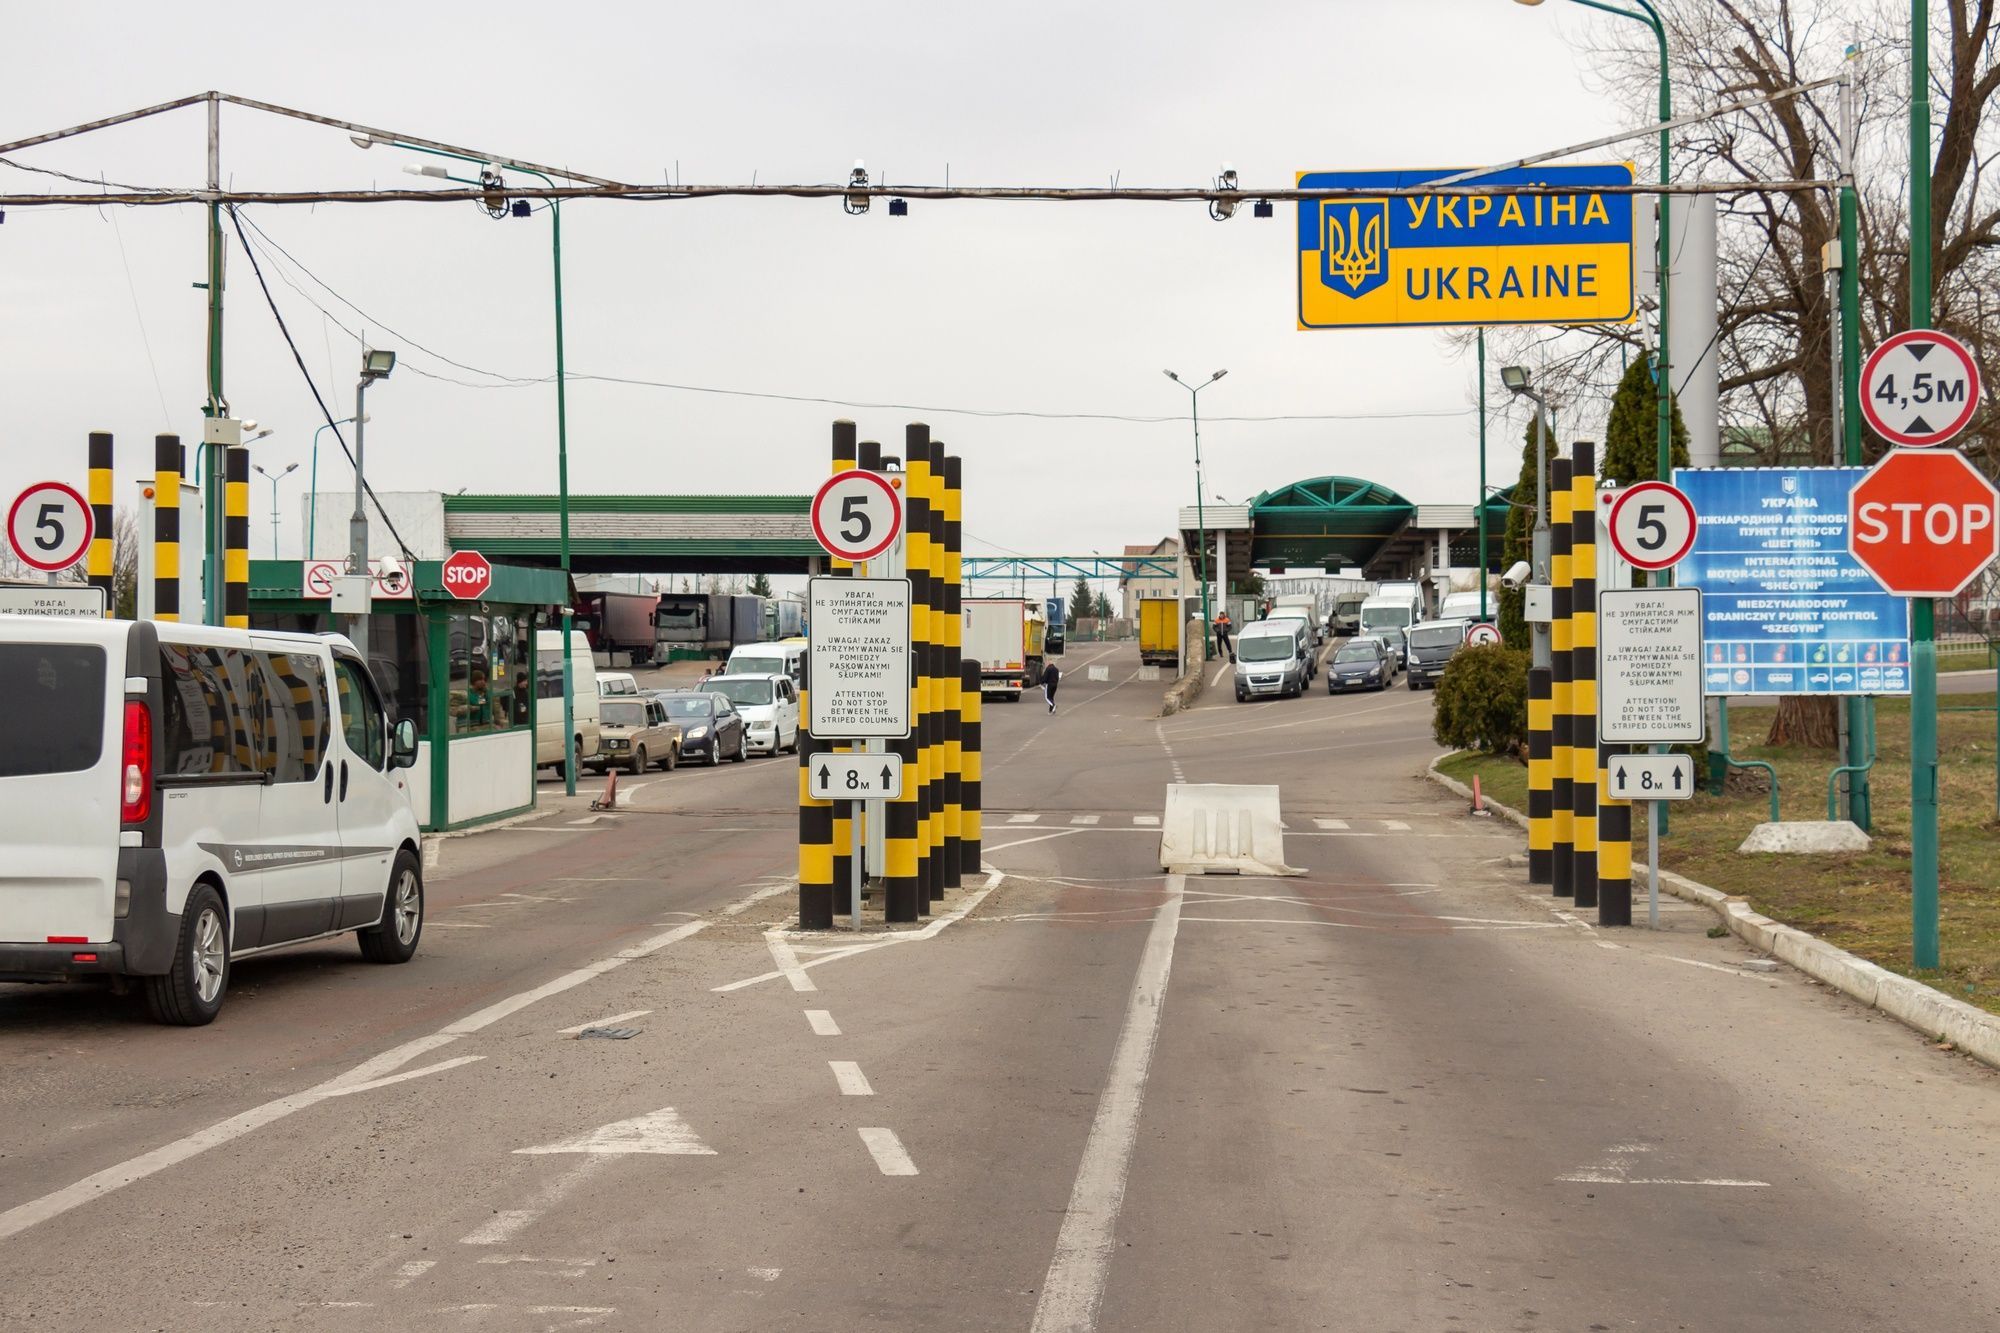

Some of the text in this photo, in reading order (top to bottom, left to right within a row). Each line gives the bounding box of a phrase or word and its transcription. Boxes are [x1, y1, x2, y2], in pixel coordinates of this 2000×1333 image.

[1406, 182, 1610, 229] УКРАЇНА
[1406, 264, 1598, 300] UKRAINE
[1762, 497, 1818, 508] УКРАЇНА
[840, 496, 871, 543] 5
[1786, 514, 1848, 524] АВТОМОБІ
[1856, 502, 1991, 544] STOP
[34, 504, 64, 550] 5
[1637, 505, 1667, 550] 5
[1740, 527, 1842, 536] ПУНКТ ПРОПУСКУ
[1744, 557, 1838, 566] INTERNATIONAL
[447, 566, 486, 583] STOP
[1707, 568, 1870, 579] MOTOR-CAR CROSSING POIN
[1736, 599, 1848, 608] MIEDZYNARODOWY
[1708, 611, 1878, 622] GRANICZNY PUNKT KONTROL
[1629, 626, 1672, 634] СТІЙКАМИ
